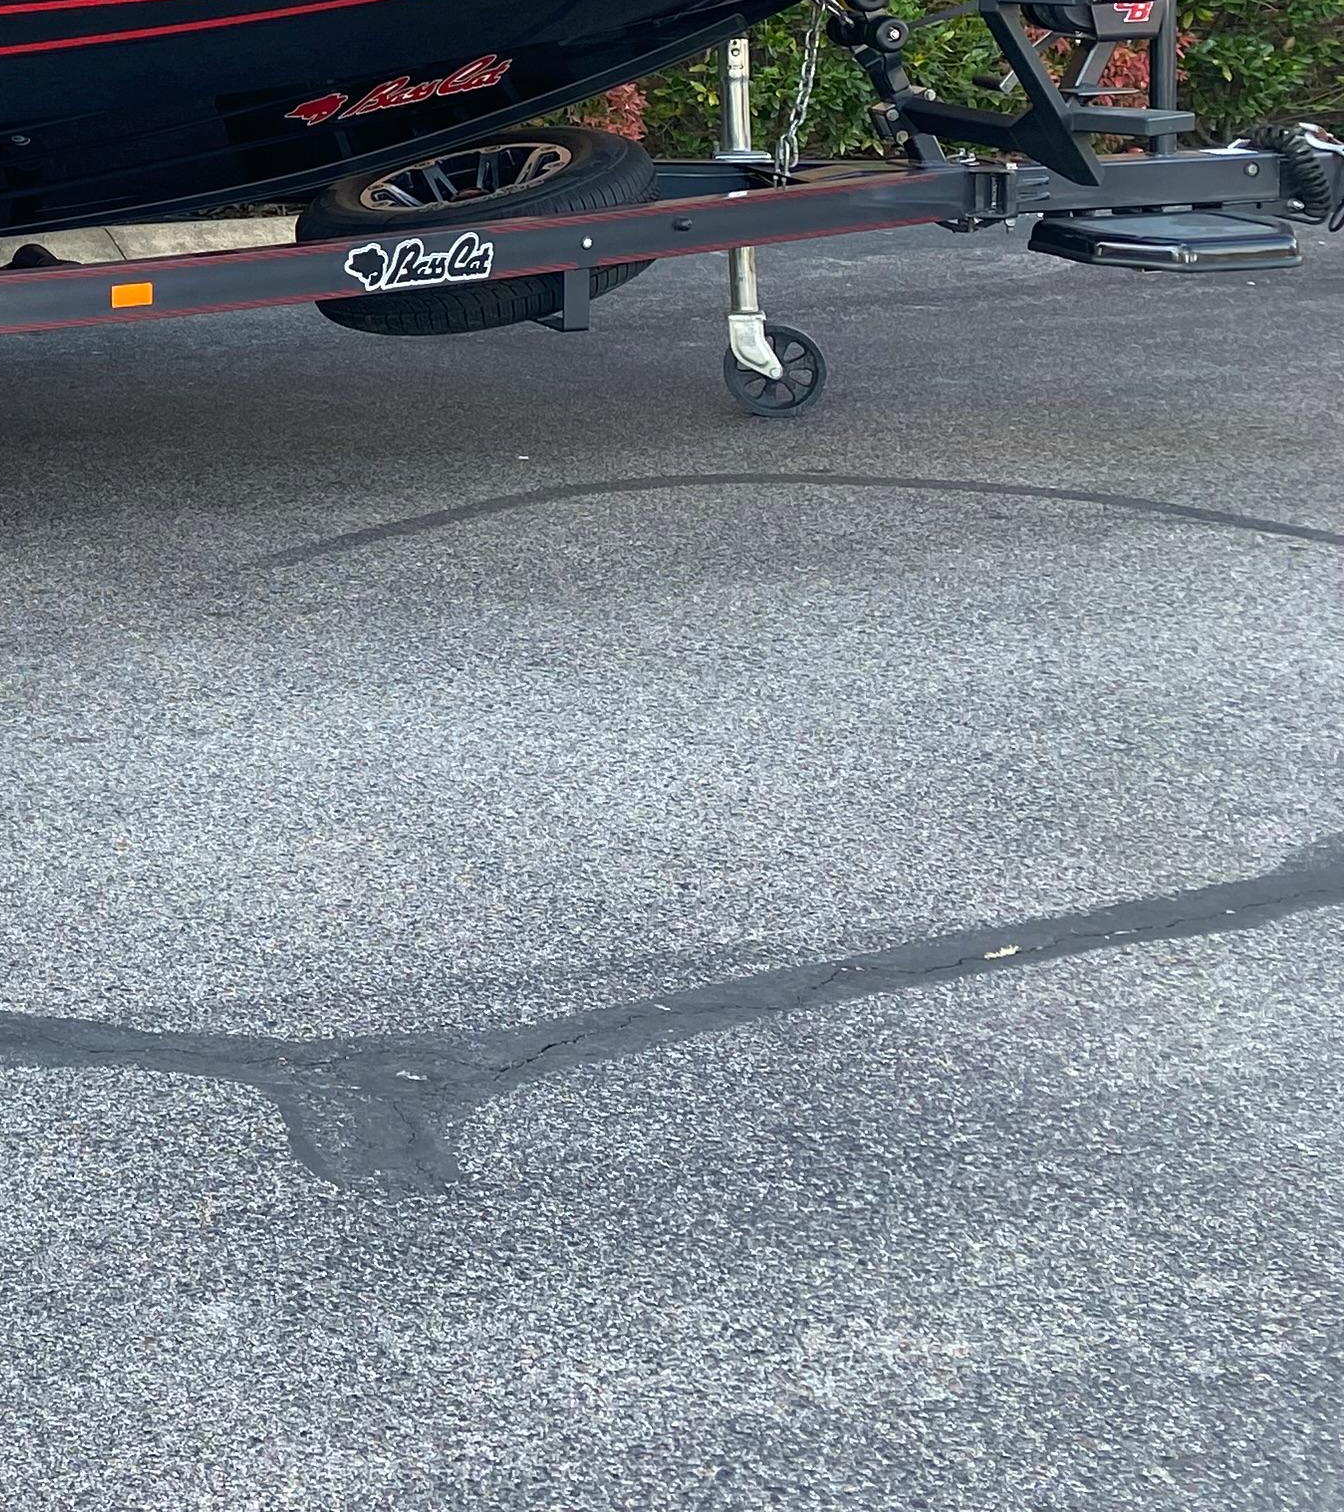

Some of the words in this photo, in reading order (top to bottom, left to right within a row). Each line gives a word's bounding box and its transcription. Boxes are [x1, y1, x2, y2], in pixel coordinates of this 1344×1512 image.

[437, 54, 512, 96] Cat
[380, 238, 449, 290] Bass
[447, 232, 493, 281] Cat
